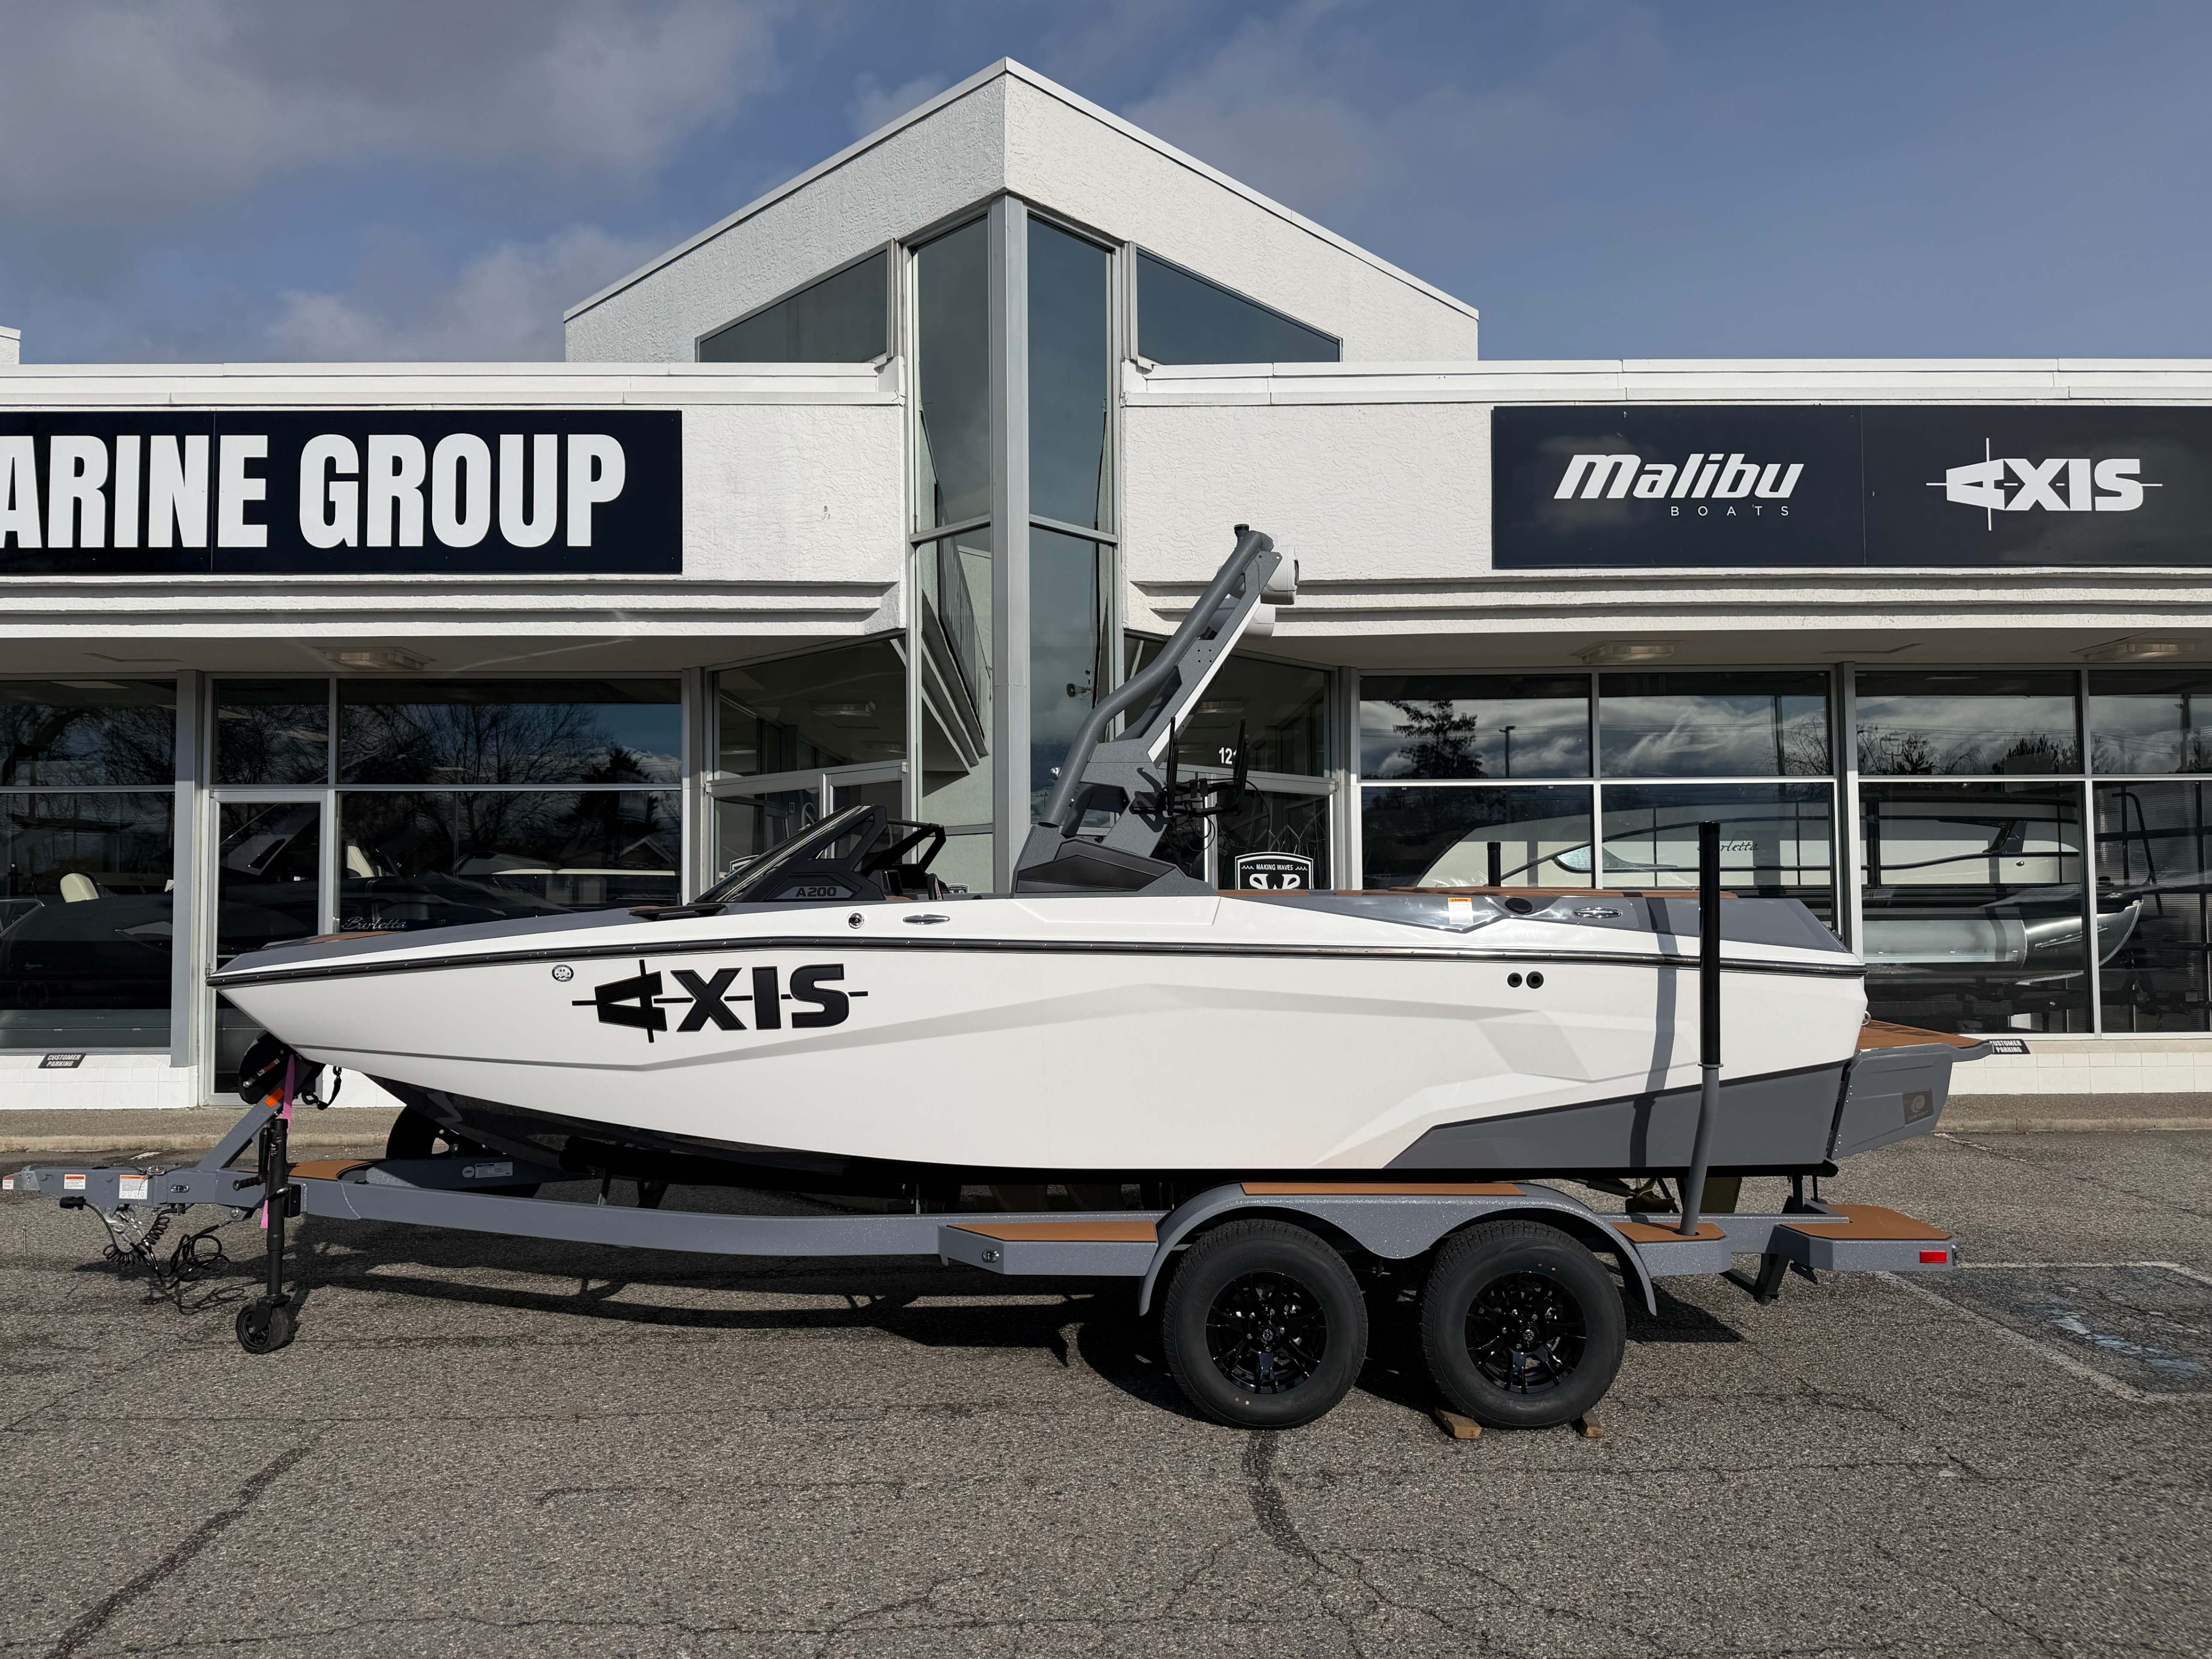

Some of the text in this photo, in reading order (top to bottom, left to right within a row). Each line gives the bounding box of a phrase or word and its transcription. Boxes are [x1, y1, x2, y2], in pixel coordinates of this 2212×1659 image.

[299, 433, 626, 549] GROUP
[1554, 453, 1805, 499] Malibu
[1926, 458, 2163, 512] AXIS
[1670, 506, 1790, 517] BOATS
[795, 887, 837, 897] A200
[341, 916, 407, 930] Barletta
[594, 963, 850, 1032] AXIS
